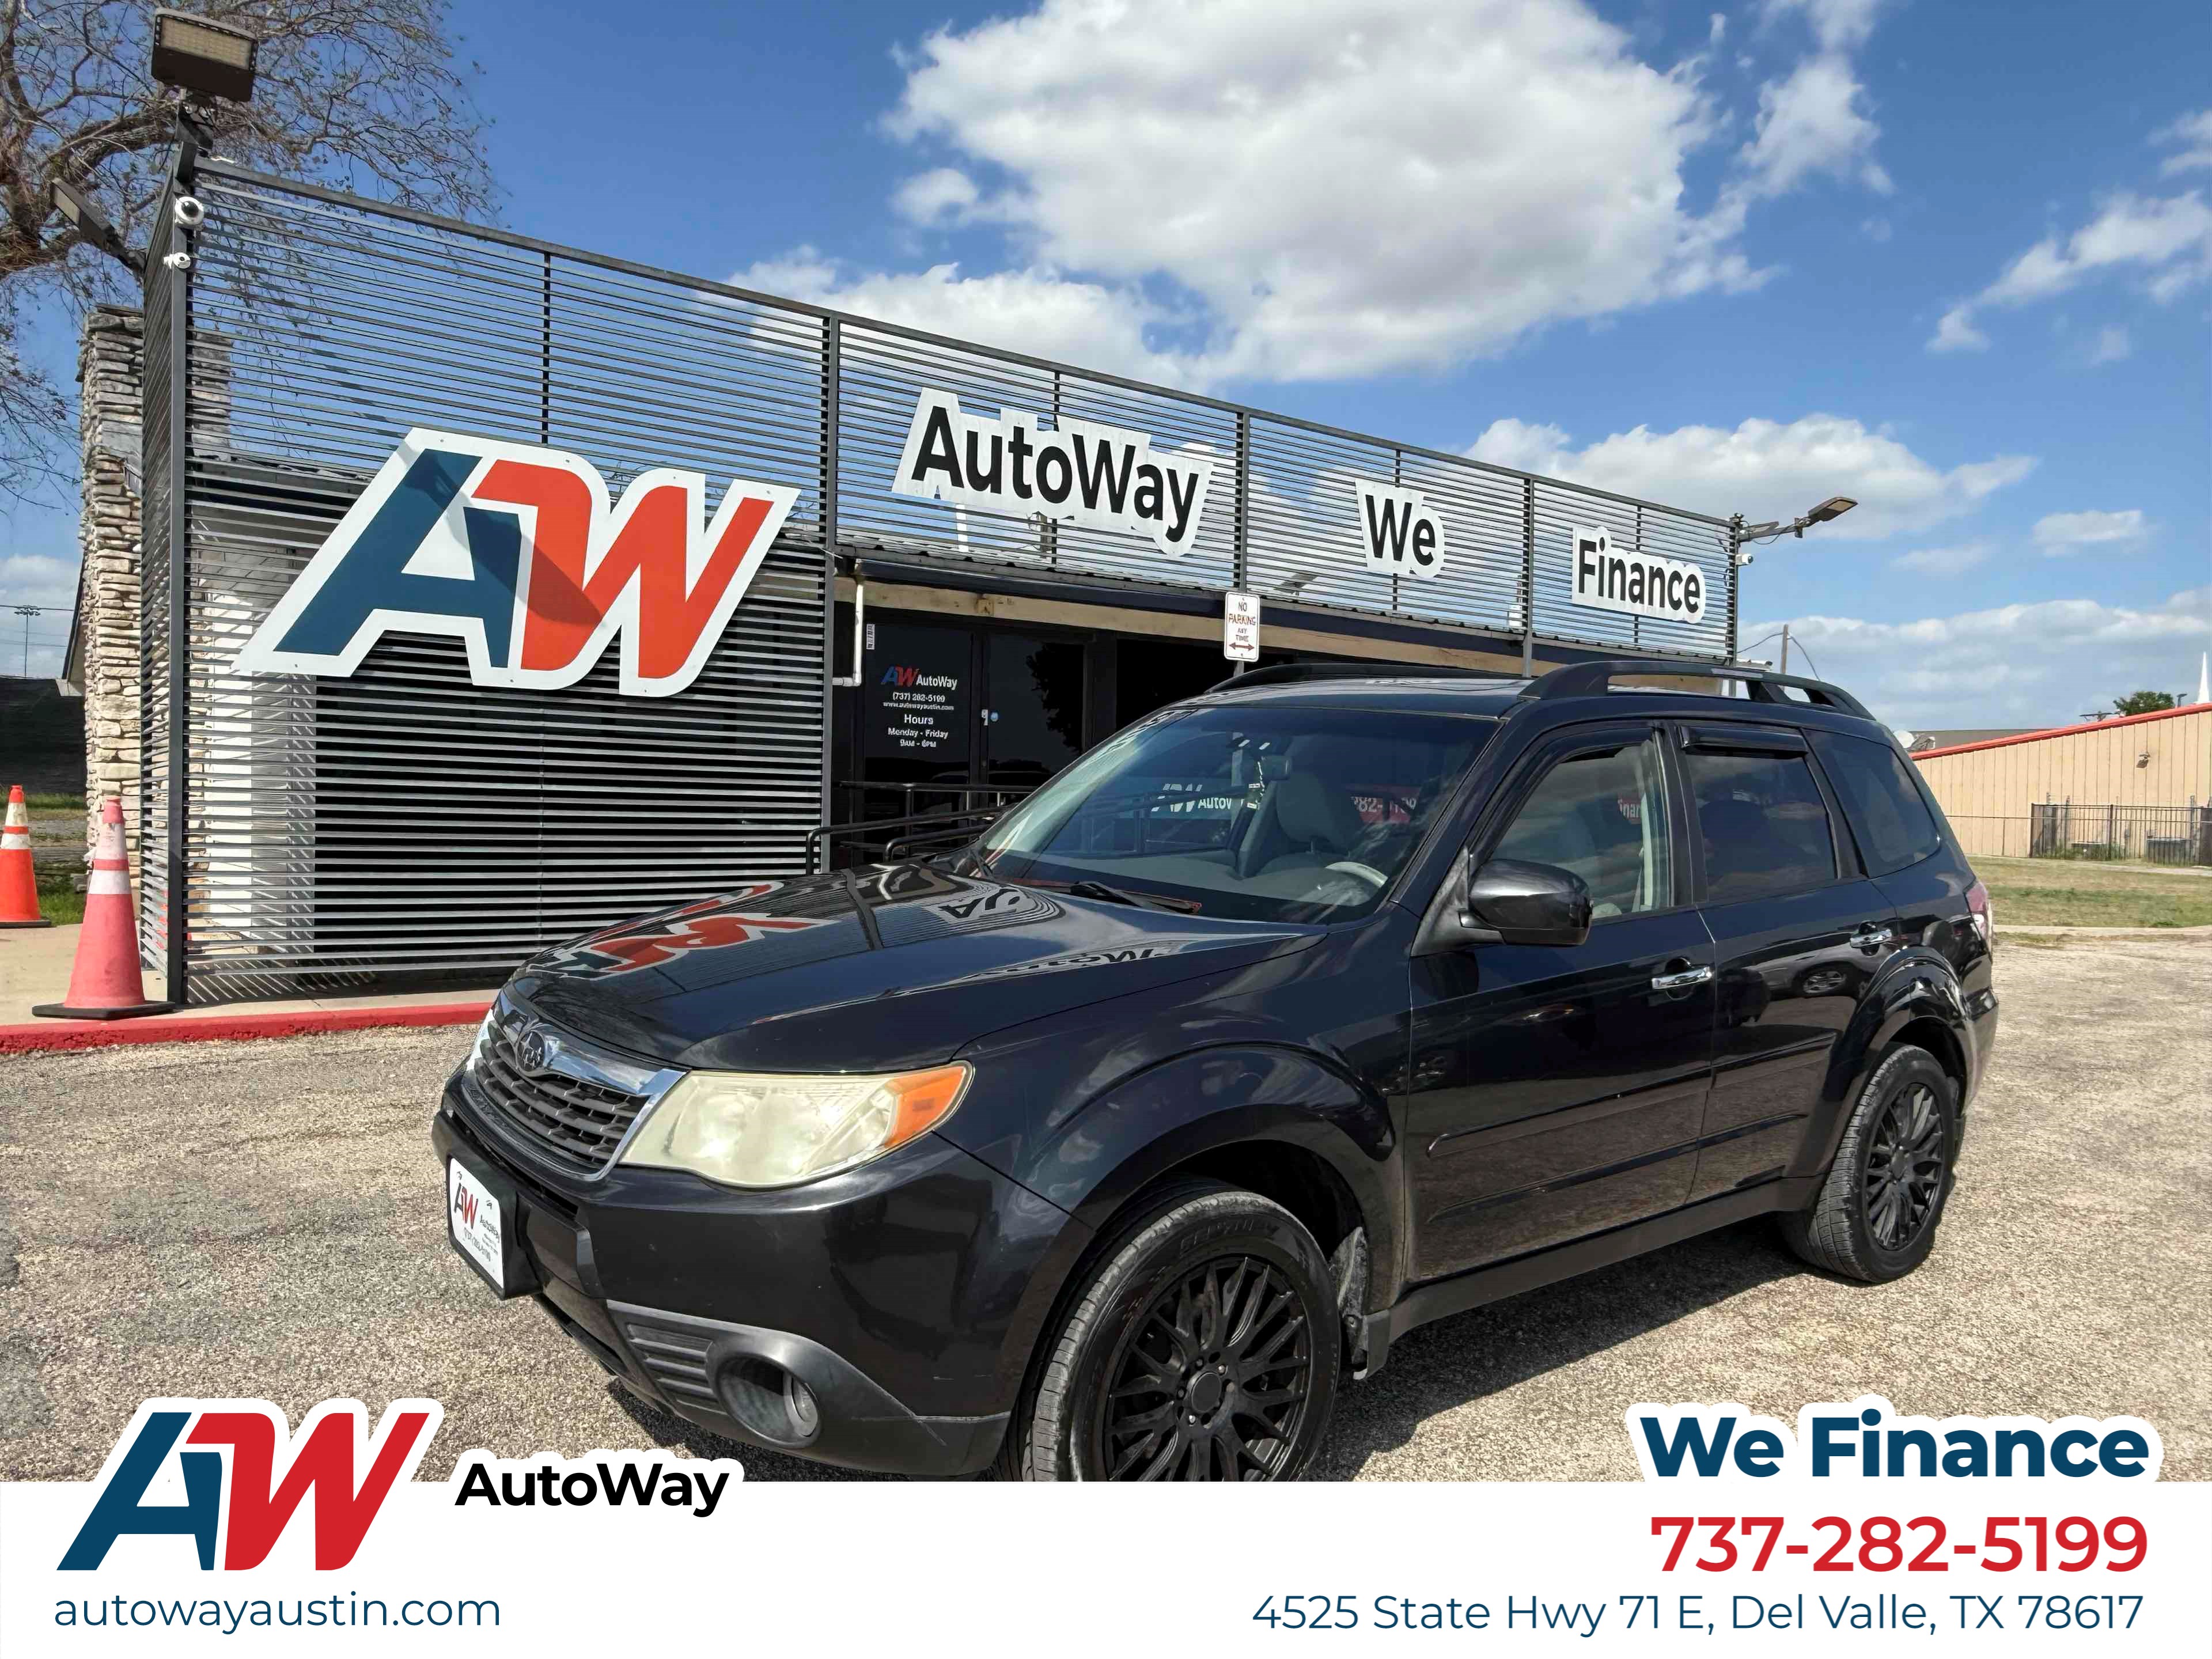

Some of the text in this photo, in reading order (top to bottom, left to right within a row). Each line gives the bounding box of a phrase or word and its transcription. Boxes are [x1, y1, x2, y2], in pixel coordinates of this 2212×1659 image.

[911, 406, 1199, 543] AutoWay
[1365, 495, 1700, 613] We Finance
[273, 448, 774, 679] AW
[1238, 602, 1247, 612] NO
[1228, 613, 1256, 626] PARKING
[916, 674, 957, 690] AutoWay
[892, 692, 910, 701] (737)
[904, 714, 934, 725] Hours
[888, 727, 918, 738] Monday
[925, 729, 949, 740] Friday
